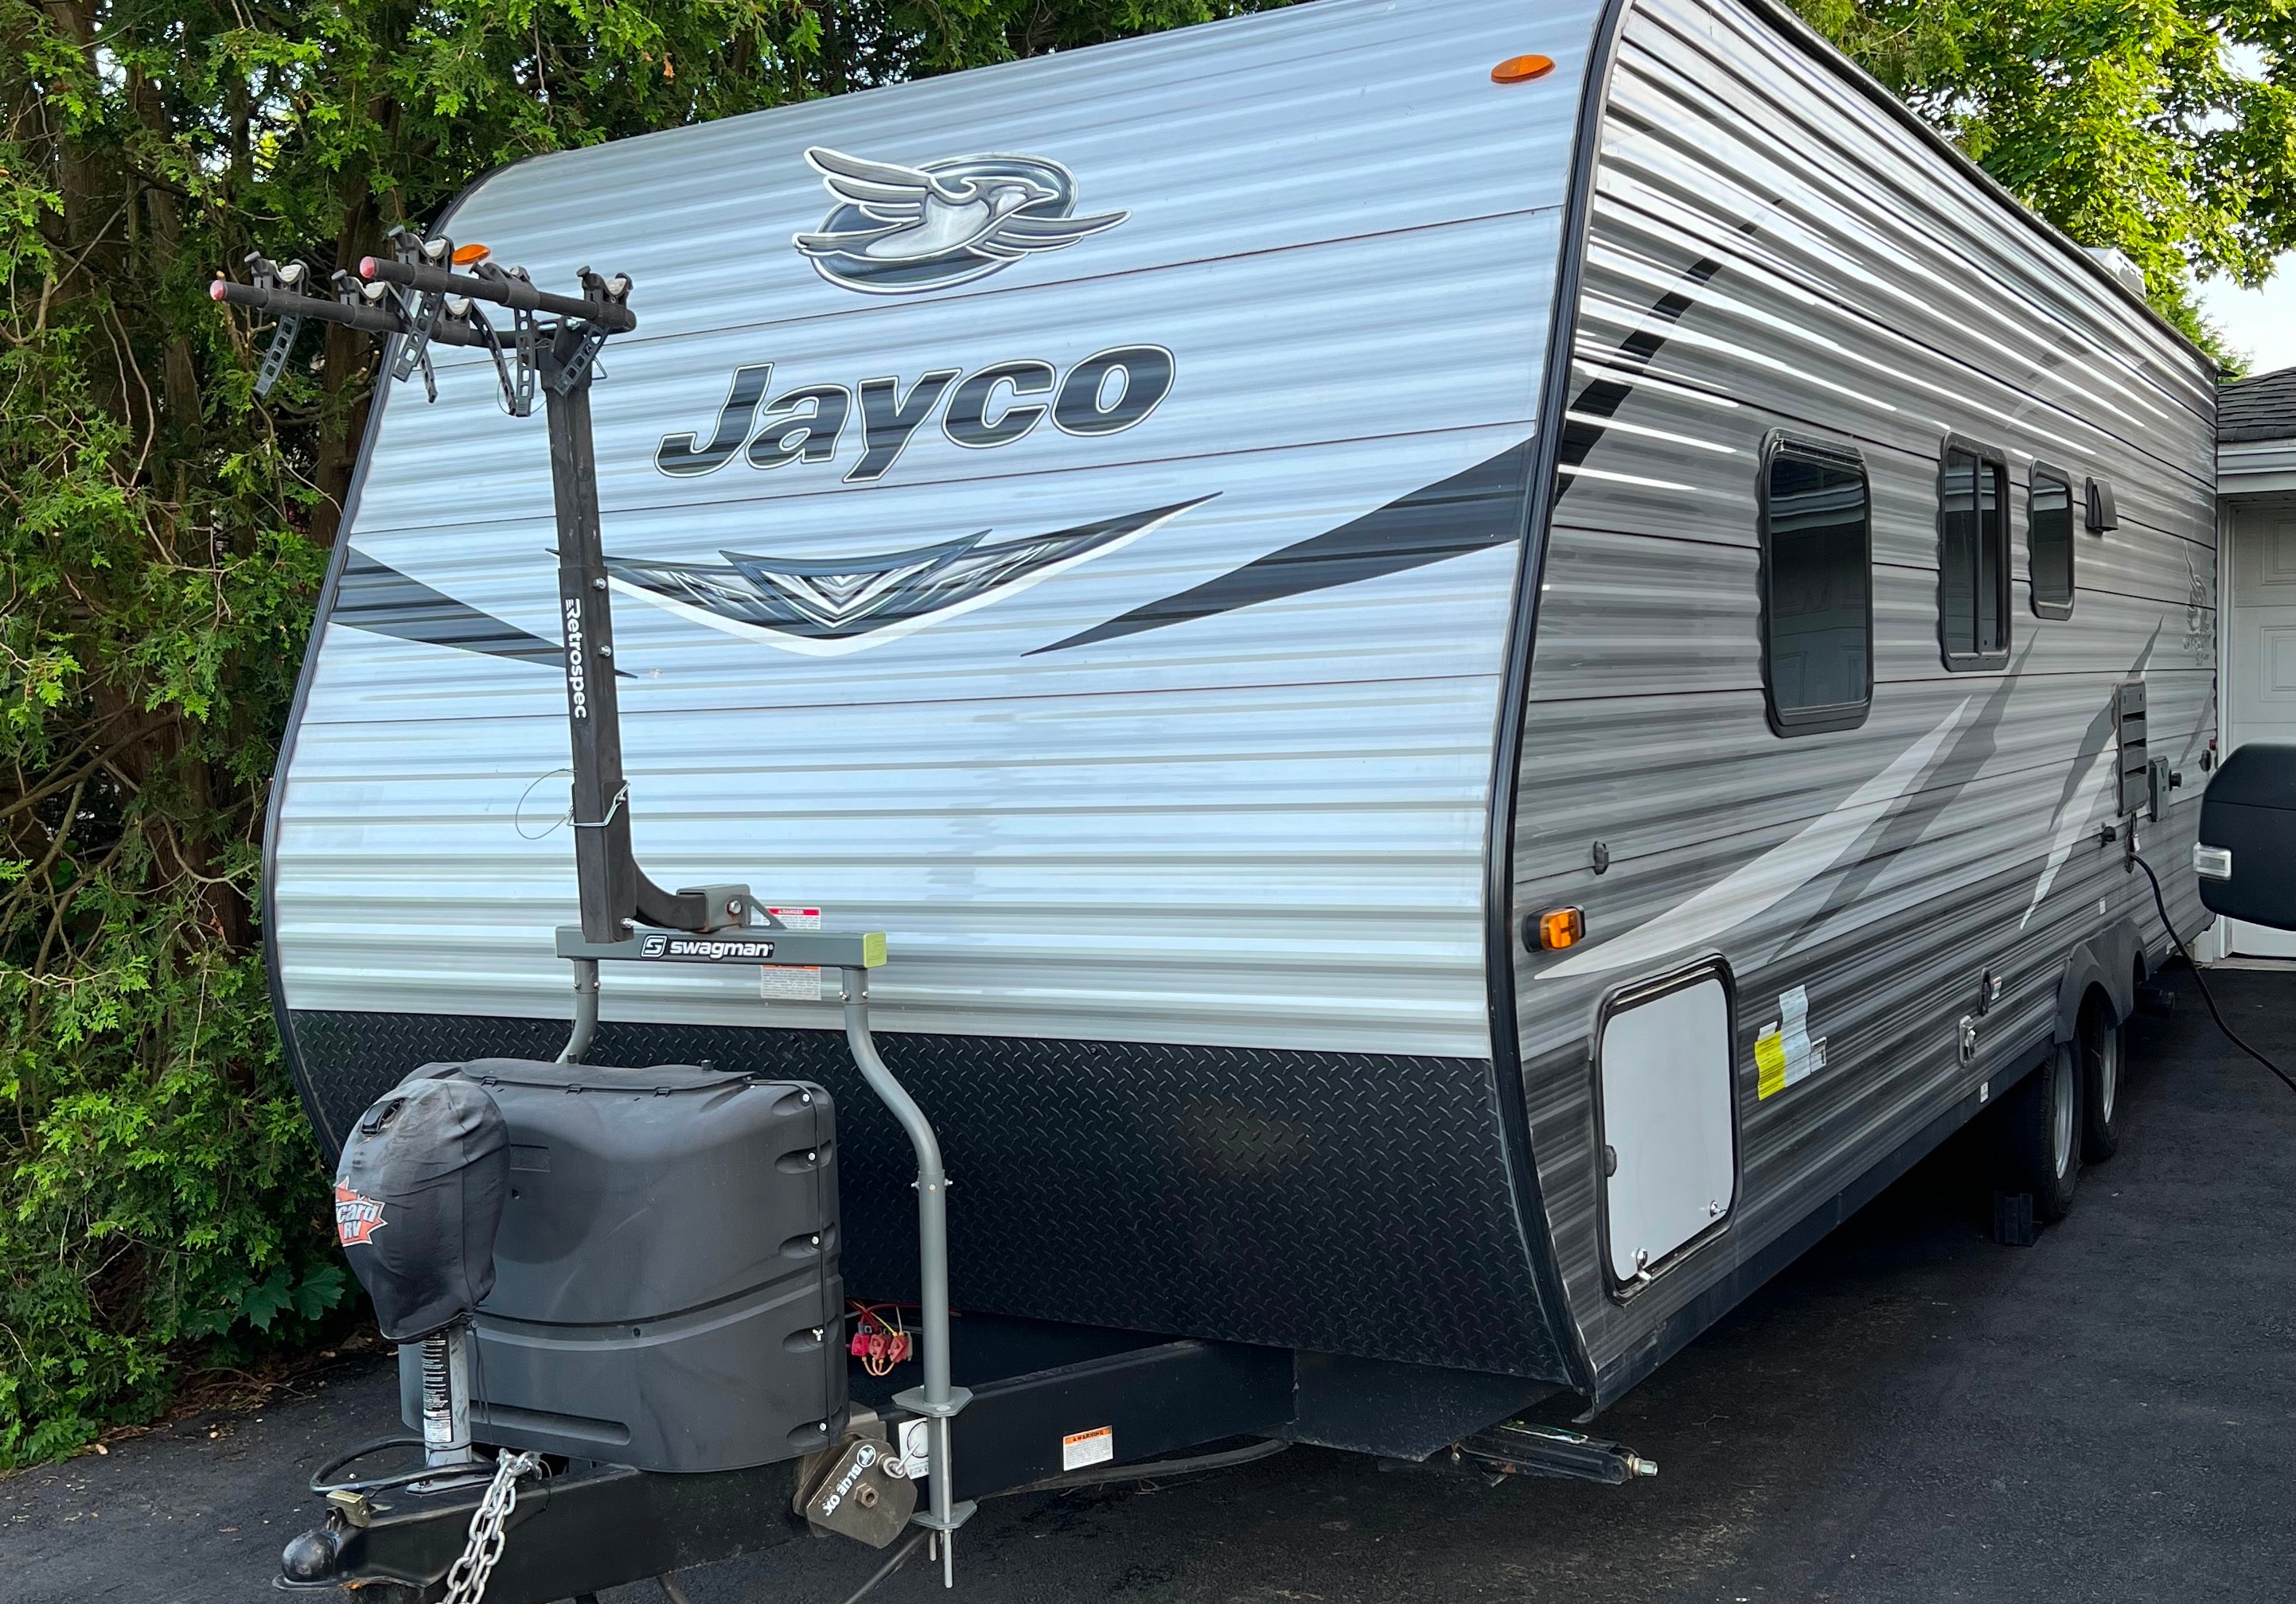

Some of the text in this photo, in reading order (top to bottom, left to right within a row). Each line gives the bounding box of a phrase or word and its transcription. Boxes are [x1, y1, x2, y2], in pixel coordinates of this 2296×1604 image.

[653, 344, 1176, 483] Jayco
[565, 598, 587, 719] Retrospec
[669, 941, 770, 959] swagman
[344, 1221, 362, 1240] RV
[822, 1463, 863, 1516] BLUE OX
